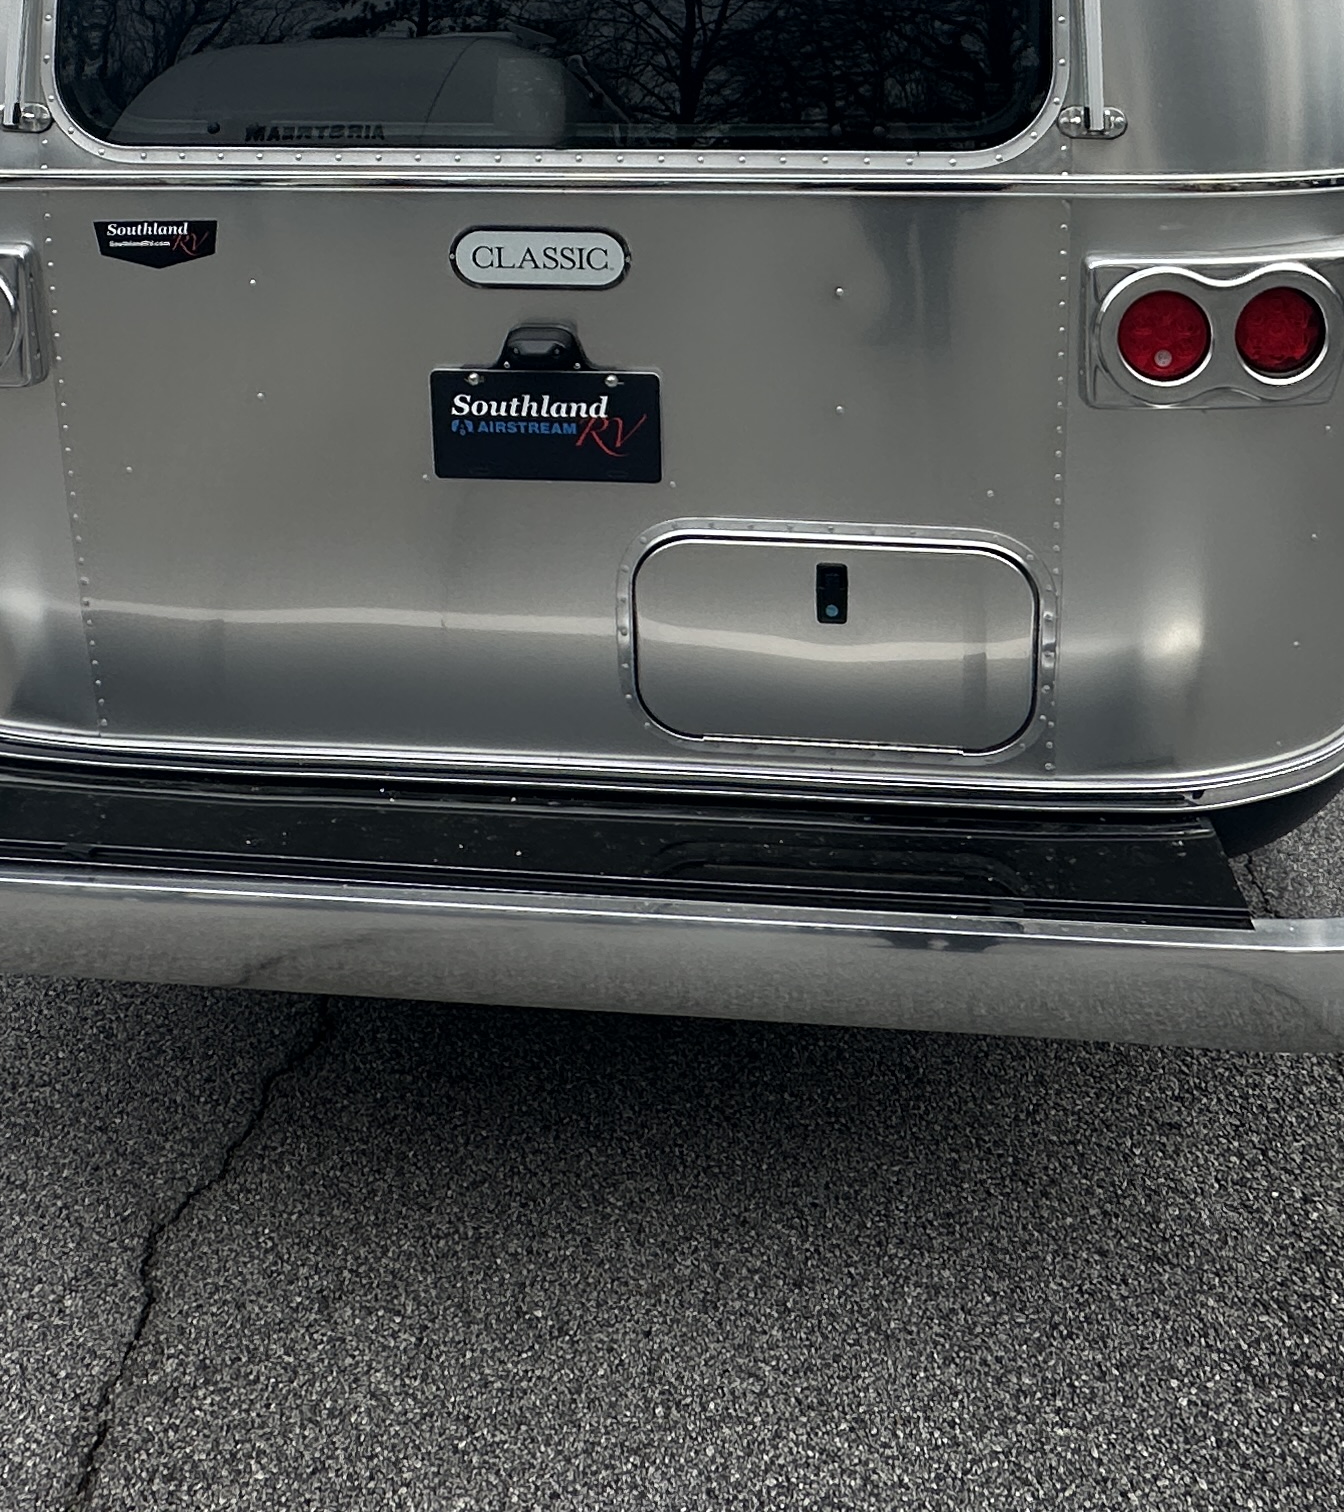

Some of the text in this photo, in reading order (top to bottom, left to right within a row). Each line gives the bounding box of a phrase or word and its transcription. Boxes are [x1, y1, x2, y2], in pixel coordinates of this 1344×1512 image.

[106, 221, 189, 236] Southland
[171, 231, 209, 256] RV
[472, 245, 608, 271] CLASSIC
[451, 393, 609, 418] Southland
[477, 420, 577, 435] AIRSTREAM
[575, 414, 647, 457] RV
